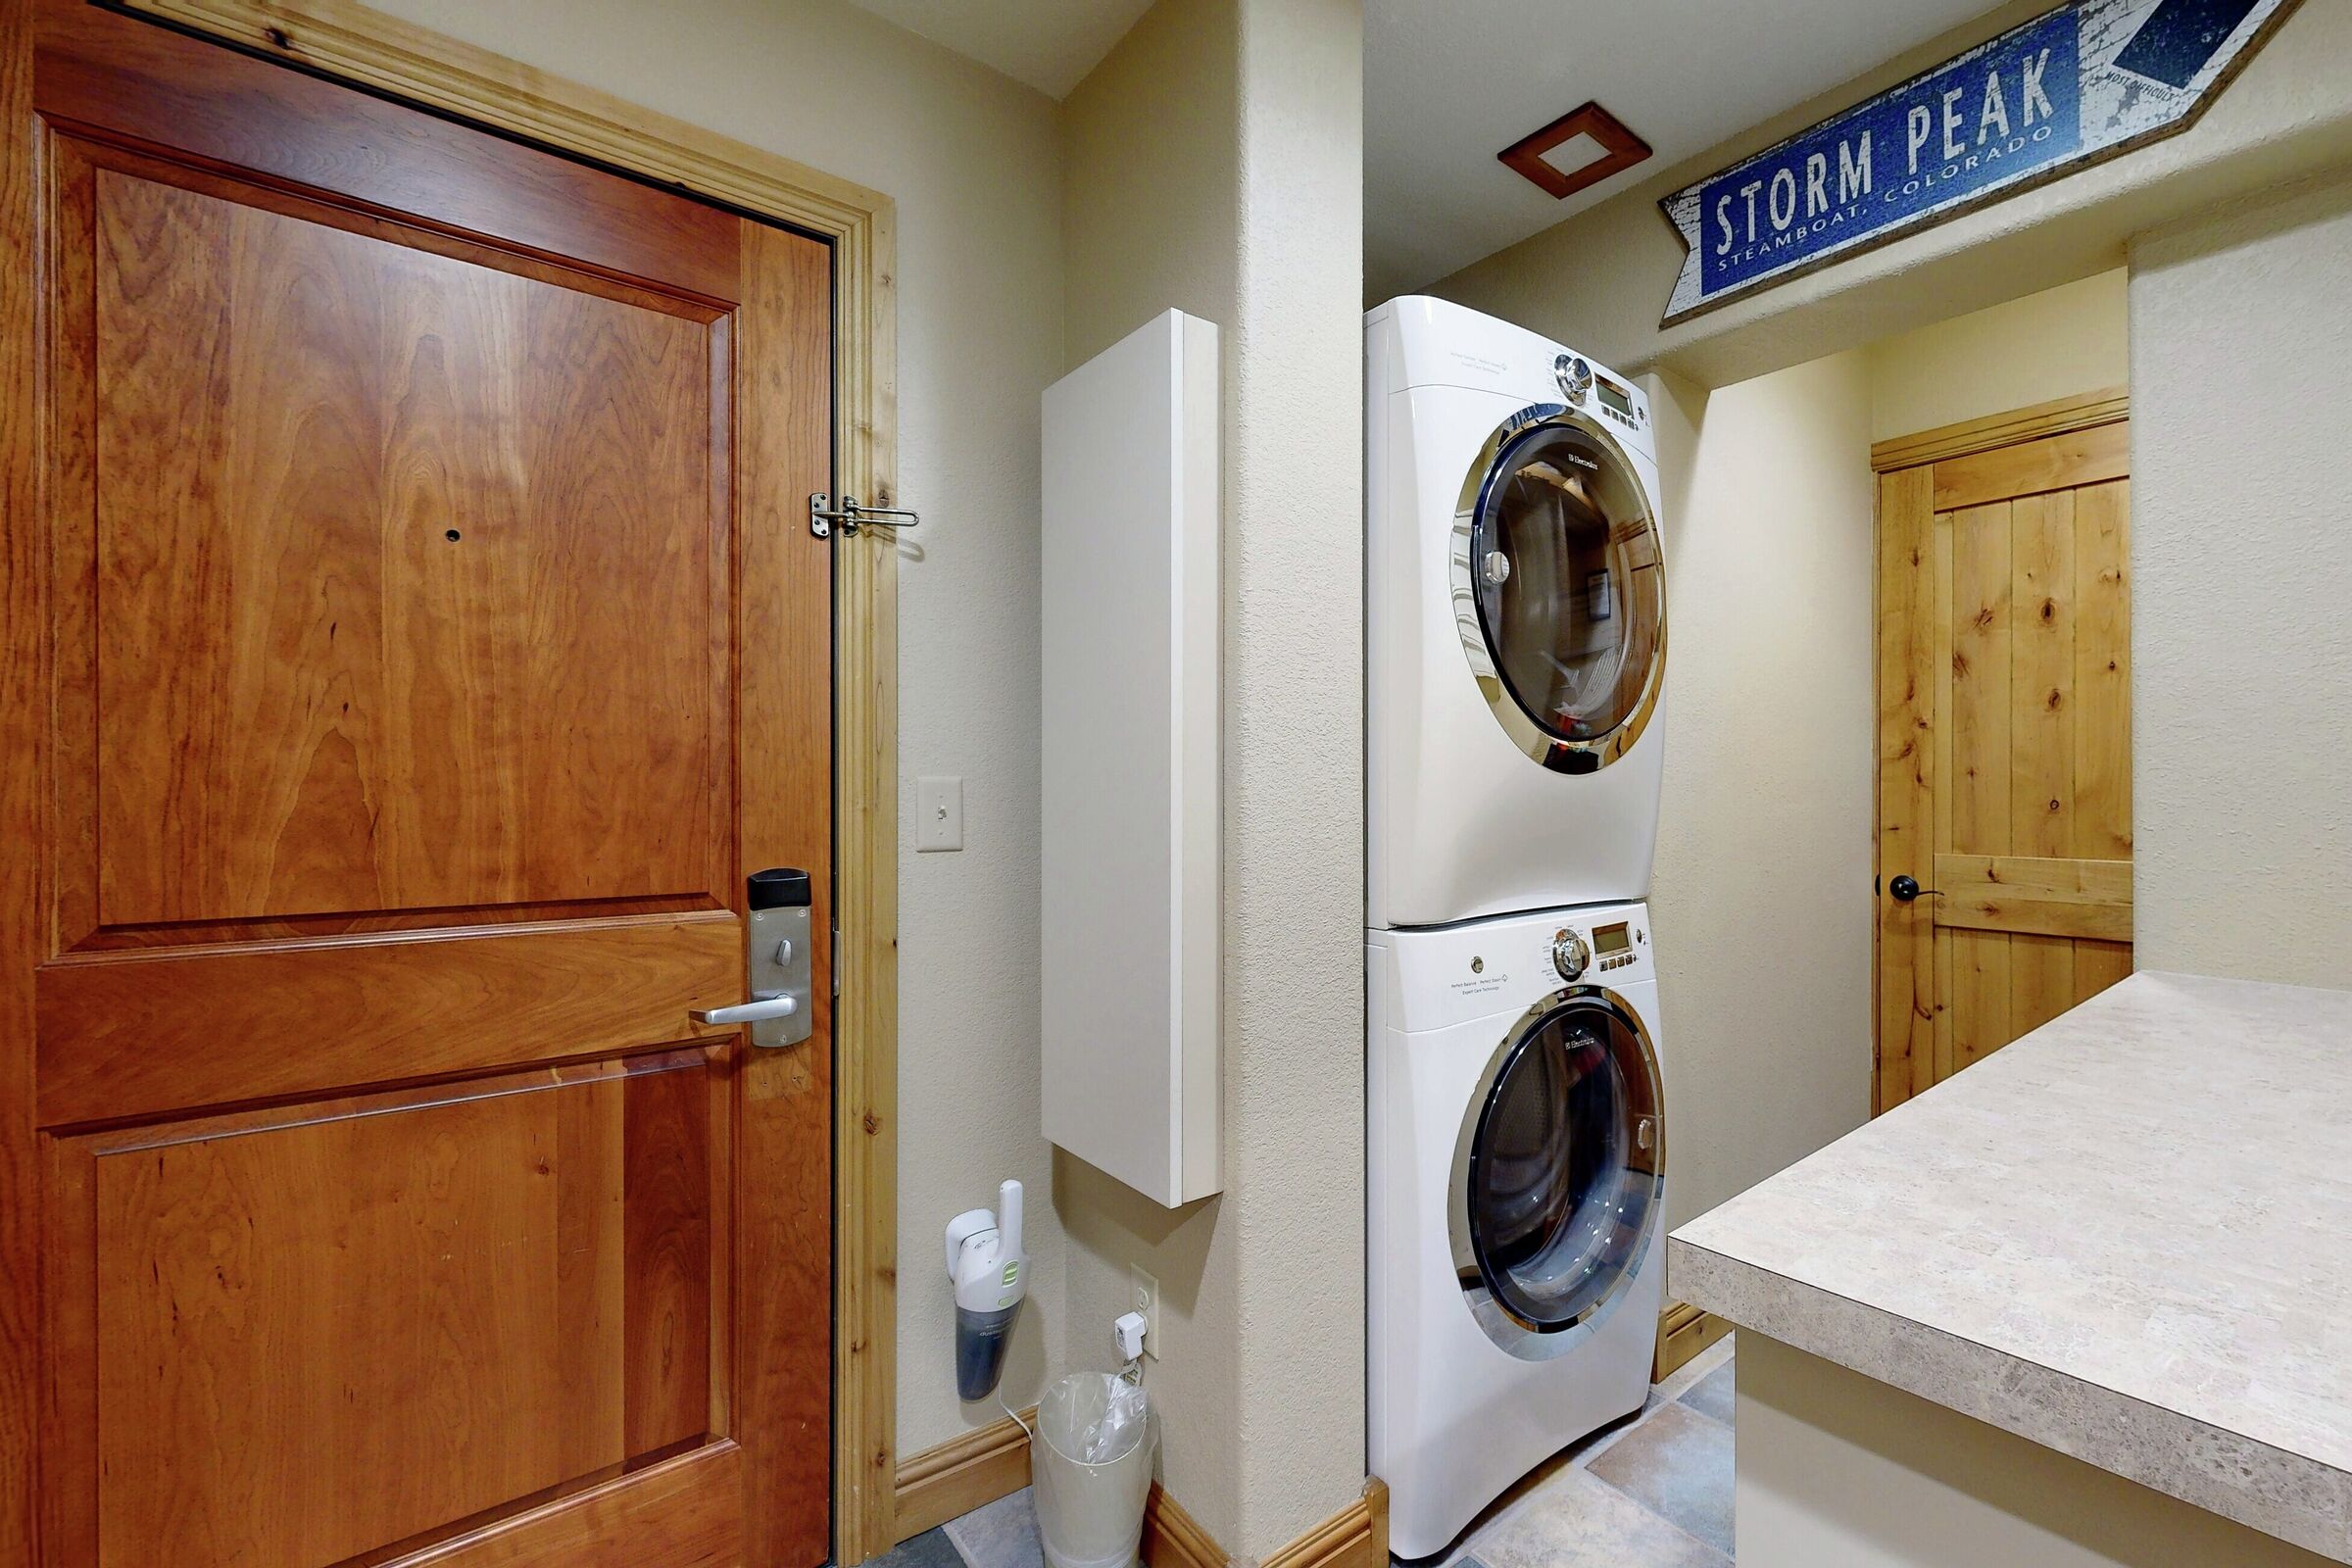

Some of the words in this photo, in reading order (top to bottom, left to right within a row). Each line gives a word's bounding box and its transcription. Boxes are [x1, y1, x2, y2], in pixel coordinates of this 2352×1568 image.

[1717, 129, 1872, 255] STORM
[1908, 48, 2053, 175] PEAK
[2105, 72, 2131, 86] MOST
[2130, 79, 2175, 102] DIFFICULT
[1718, 204, 1867, 271] STEAMBOAT,
[1884, 125, 2052, 202] COLORADO
